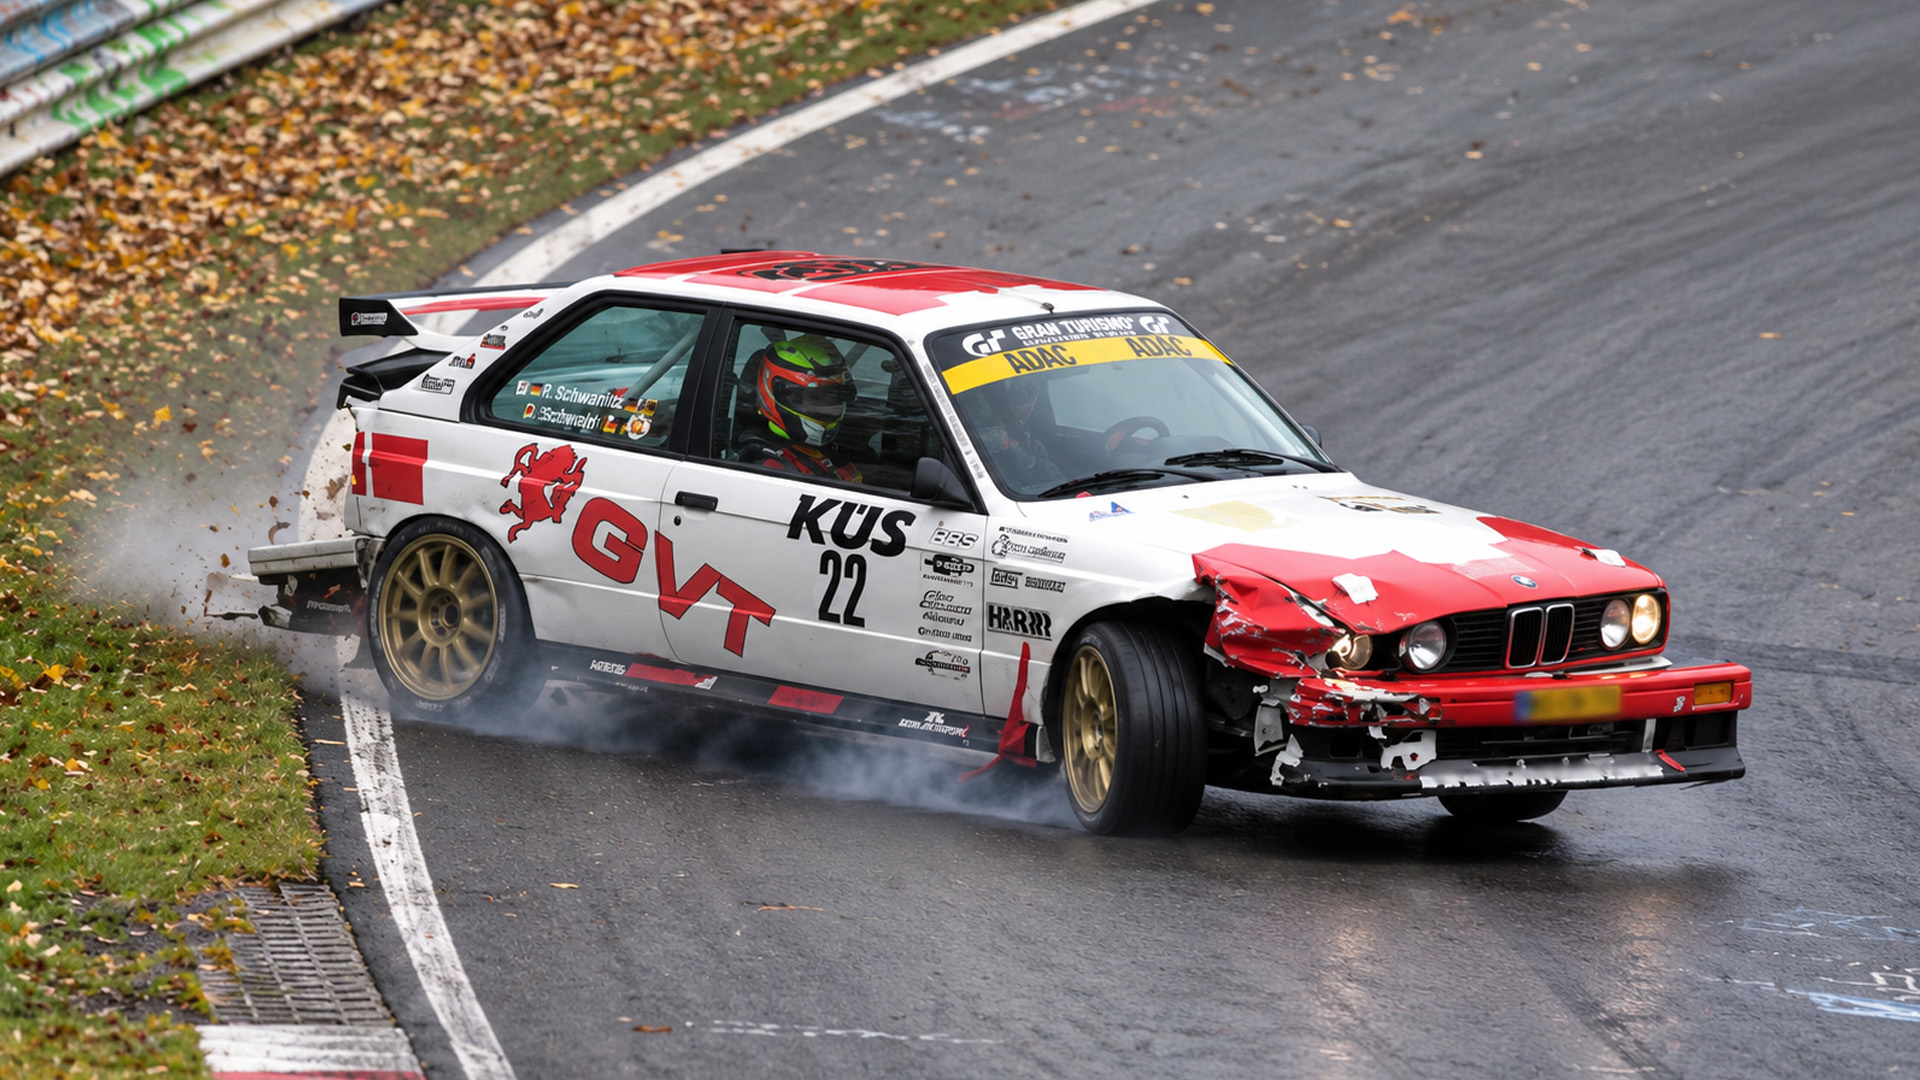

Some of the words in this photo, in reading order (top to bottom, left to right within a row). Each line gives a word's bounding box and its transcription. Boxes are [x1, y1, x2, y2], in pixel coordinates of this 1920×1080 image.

[1011, 322, 1057, 341] GRAN
[1060, 316, 1132, 335] TURISMO
[1003, 344, 1077, 374] ADAC
[1124, 334, 1192, 358] ADAC
[786, 493, 917, 557] KÜS
[929, 527, 979, 550] BBS
[572, 496, 777, 658] GVT
[818, 549, 867, 628] 22
